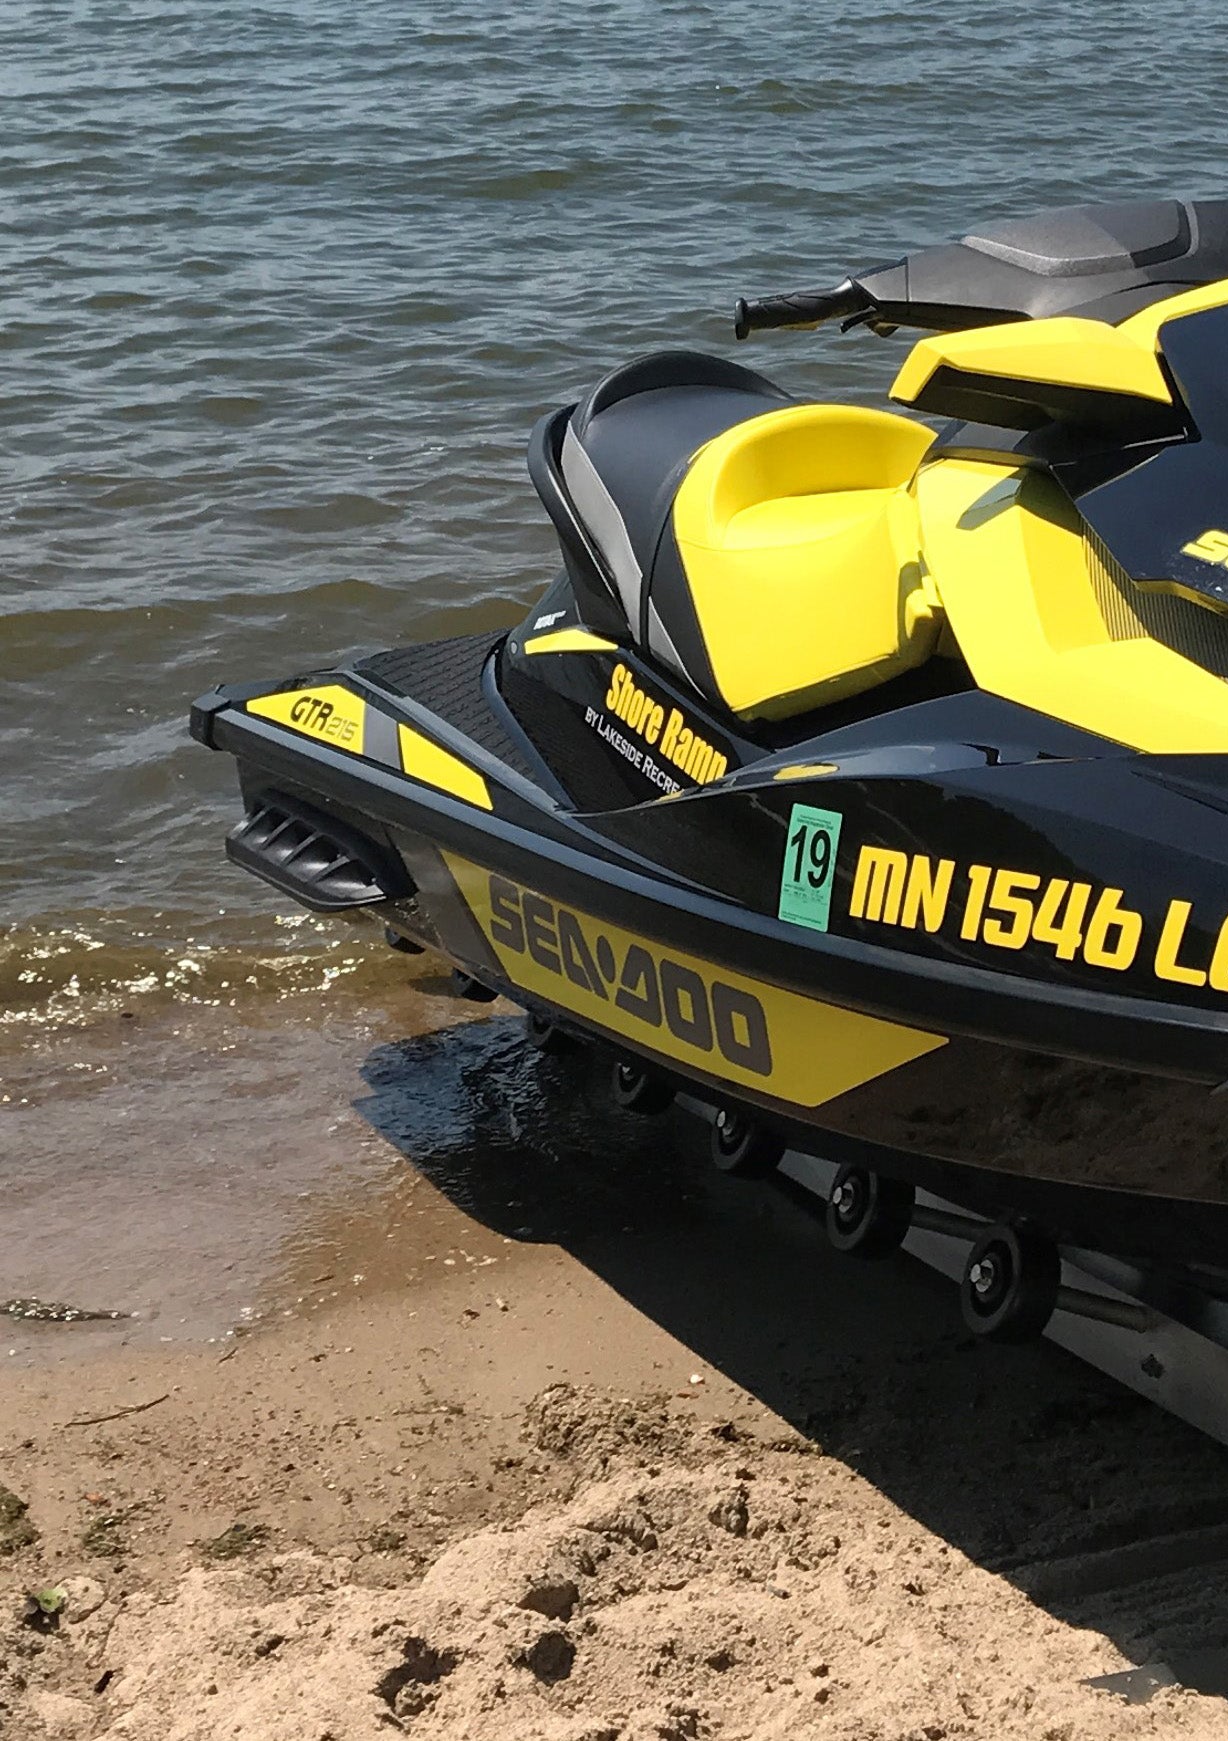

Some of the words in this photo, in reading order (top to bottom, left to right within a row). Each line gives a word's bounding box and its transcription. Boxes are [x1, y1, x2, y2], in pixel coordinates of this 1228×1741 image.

[290, 696, 334, 732] GTR
[325, 716, 359, 742] 215
[606, 664, 664, 745] Shore
[584, 706, 600, 728] BY
[597, 715, 644, 769] LAKESIDE
[790, 824, 831, 889] 19
[849, 845, 956, 933] MN
[959, 864, 1143, 971] 1546
